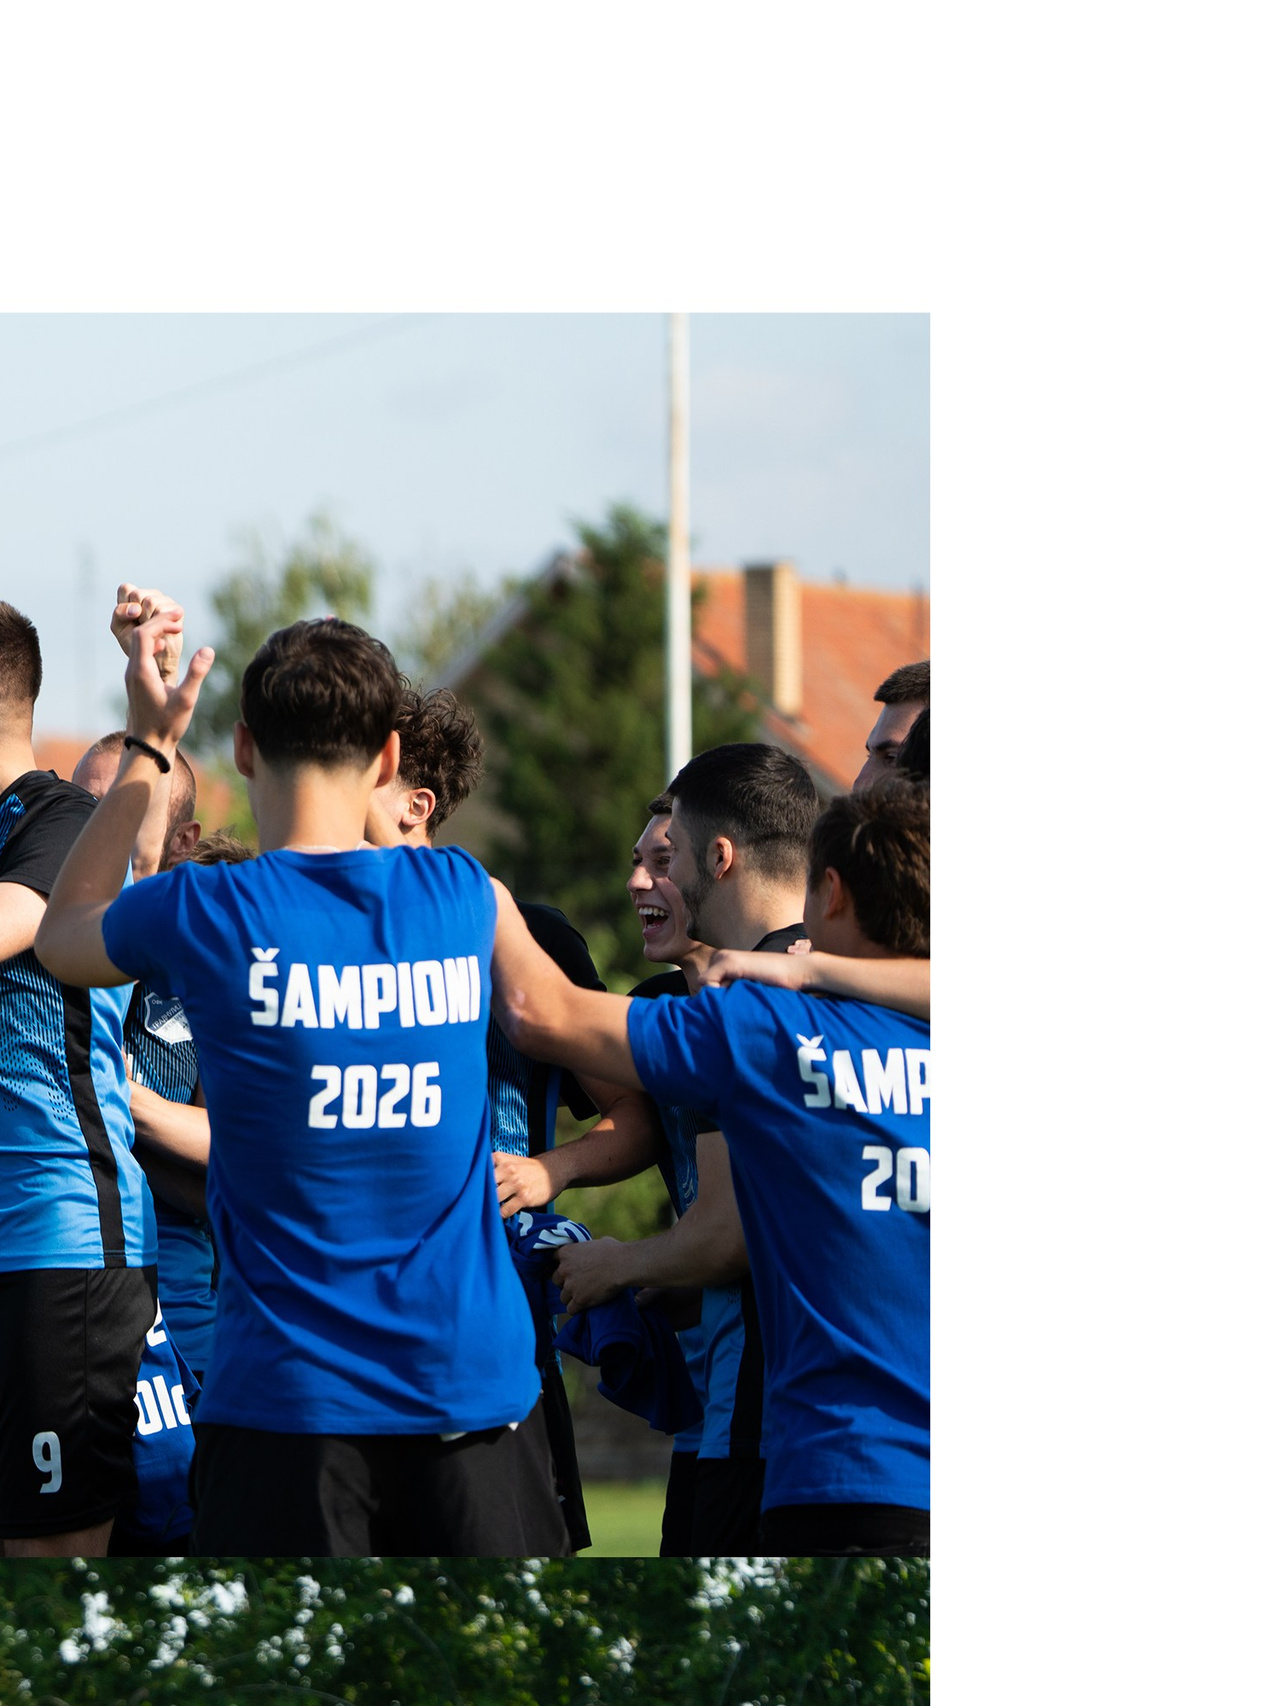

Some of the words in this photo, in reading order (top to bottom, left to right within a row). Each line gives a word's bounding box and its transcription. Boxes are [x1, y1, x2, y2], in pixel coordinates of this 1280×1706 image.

[248, 947, 481, 1029] ŠAMPIONI
[308, 1061, 442, 1129] 2026
[796, 1033, 931, 1115] ŠAMP
[861, 1145, 931, 1214] 20
[31, 1430, 63, 1494] 9
